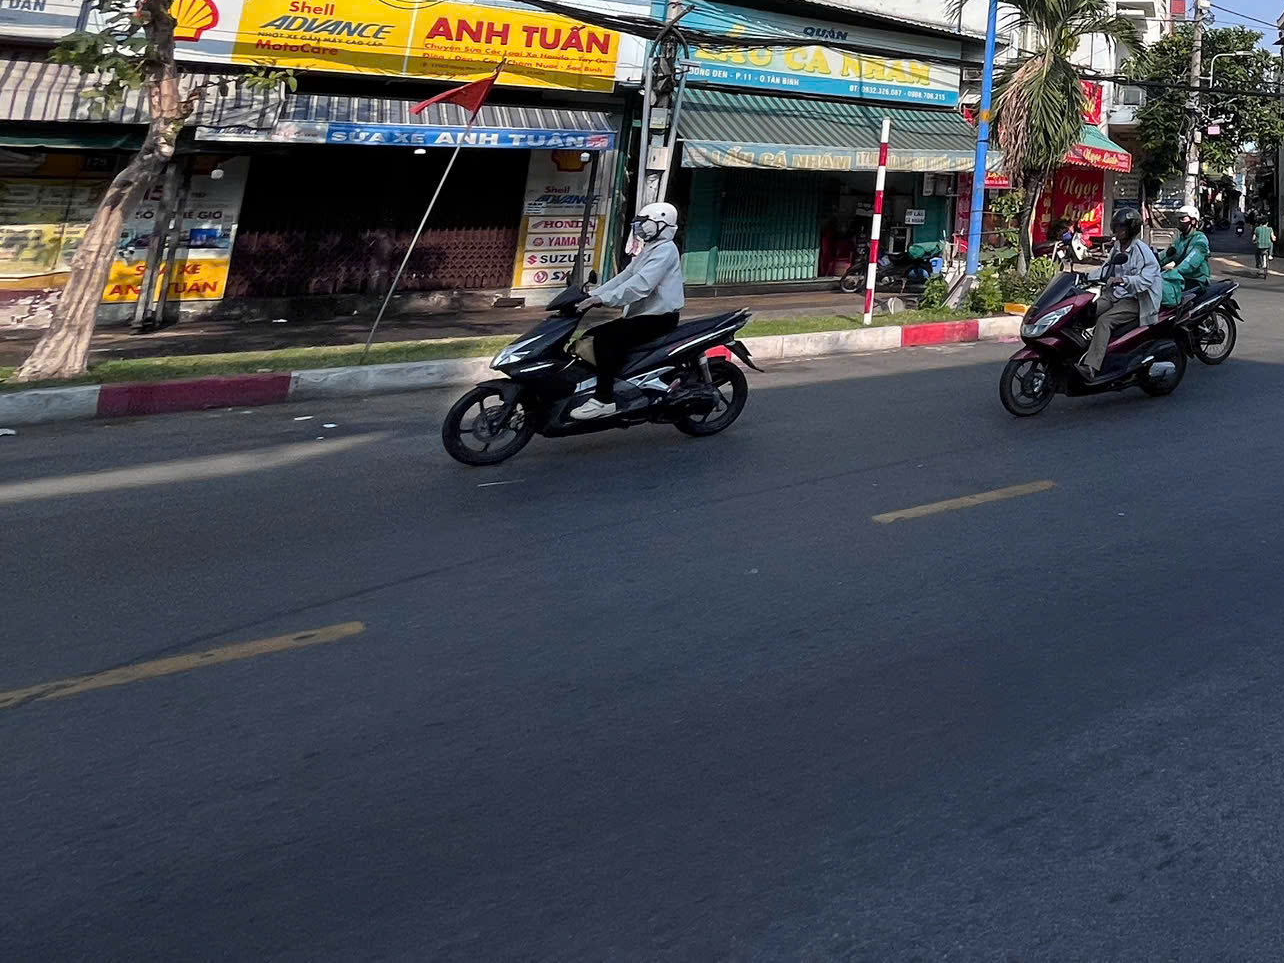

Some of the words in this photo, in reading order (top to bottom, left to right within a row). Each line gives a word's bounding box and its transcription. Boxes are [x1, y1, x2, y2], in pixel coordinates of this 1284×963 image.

[288, 0, 336, 16] Shell
[258, 14, 396, 40] ADVANCE
[426, 17, 510, 46] ANH
[521, 25, 611, 55] TUẤN
[391, 133, 426, 144] XE
[434, 132, 499, 146] ANH
[543, 185, 570, 194] Shell
